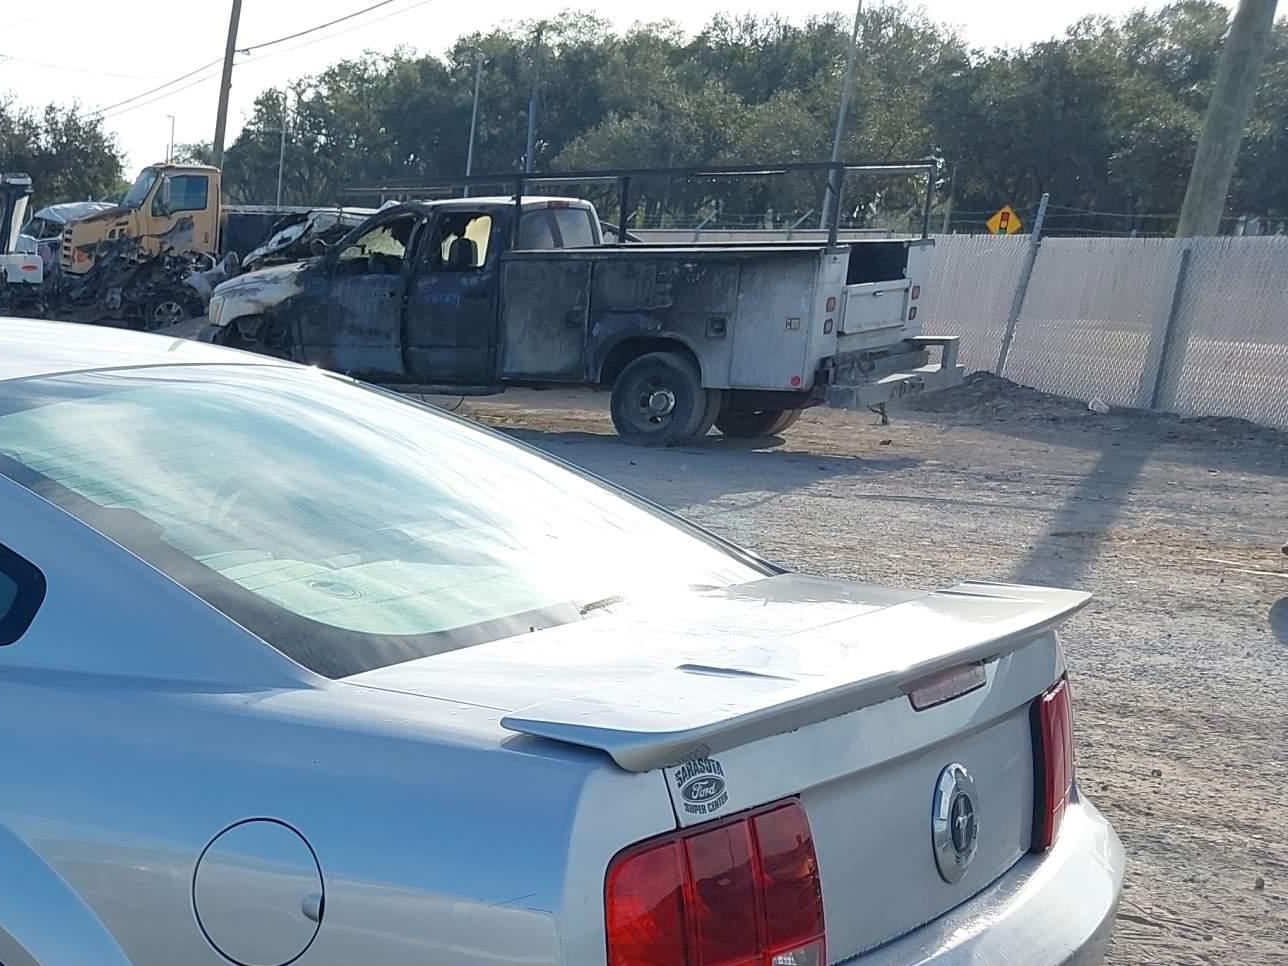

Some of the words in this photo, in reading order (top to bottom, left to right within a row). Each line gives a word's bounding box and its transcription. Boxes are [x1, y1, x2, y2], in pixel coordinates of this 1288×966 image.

[675, 758, 724, 788] SARASOTA
[683, 802, 708, 814] SUPER
[708, 790, 729, 813] CENTER
[691, 781, 717, 799] Ford
